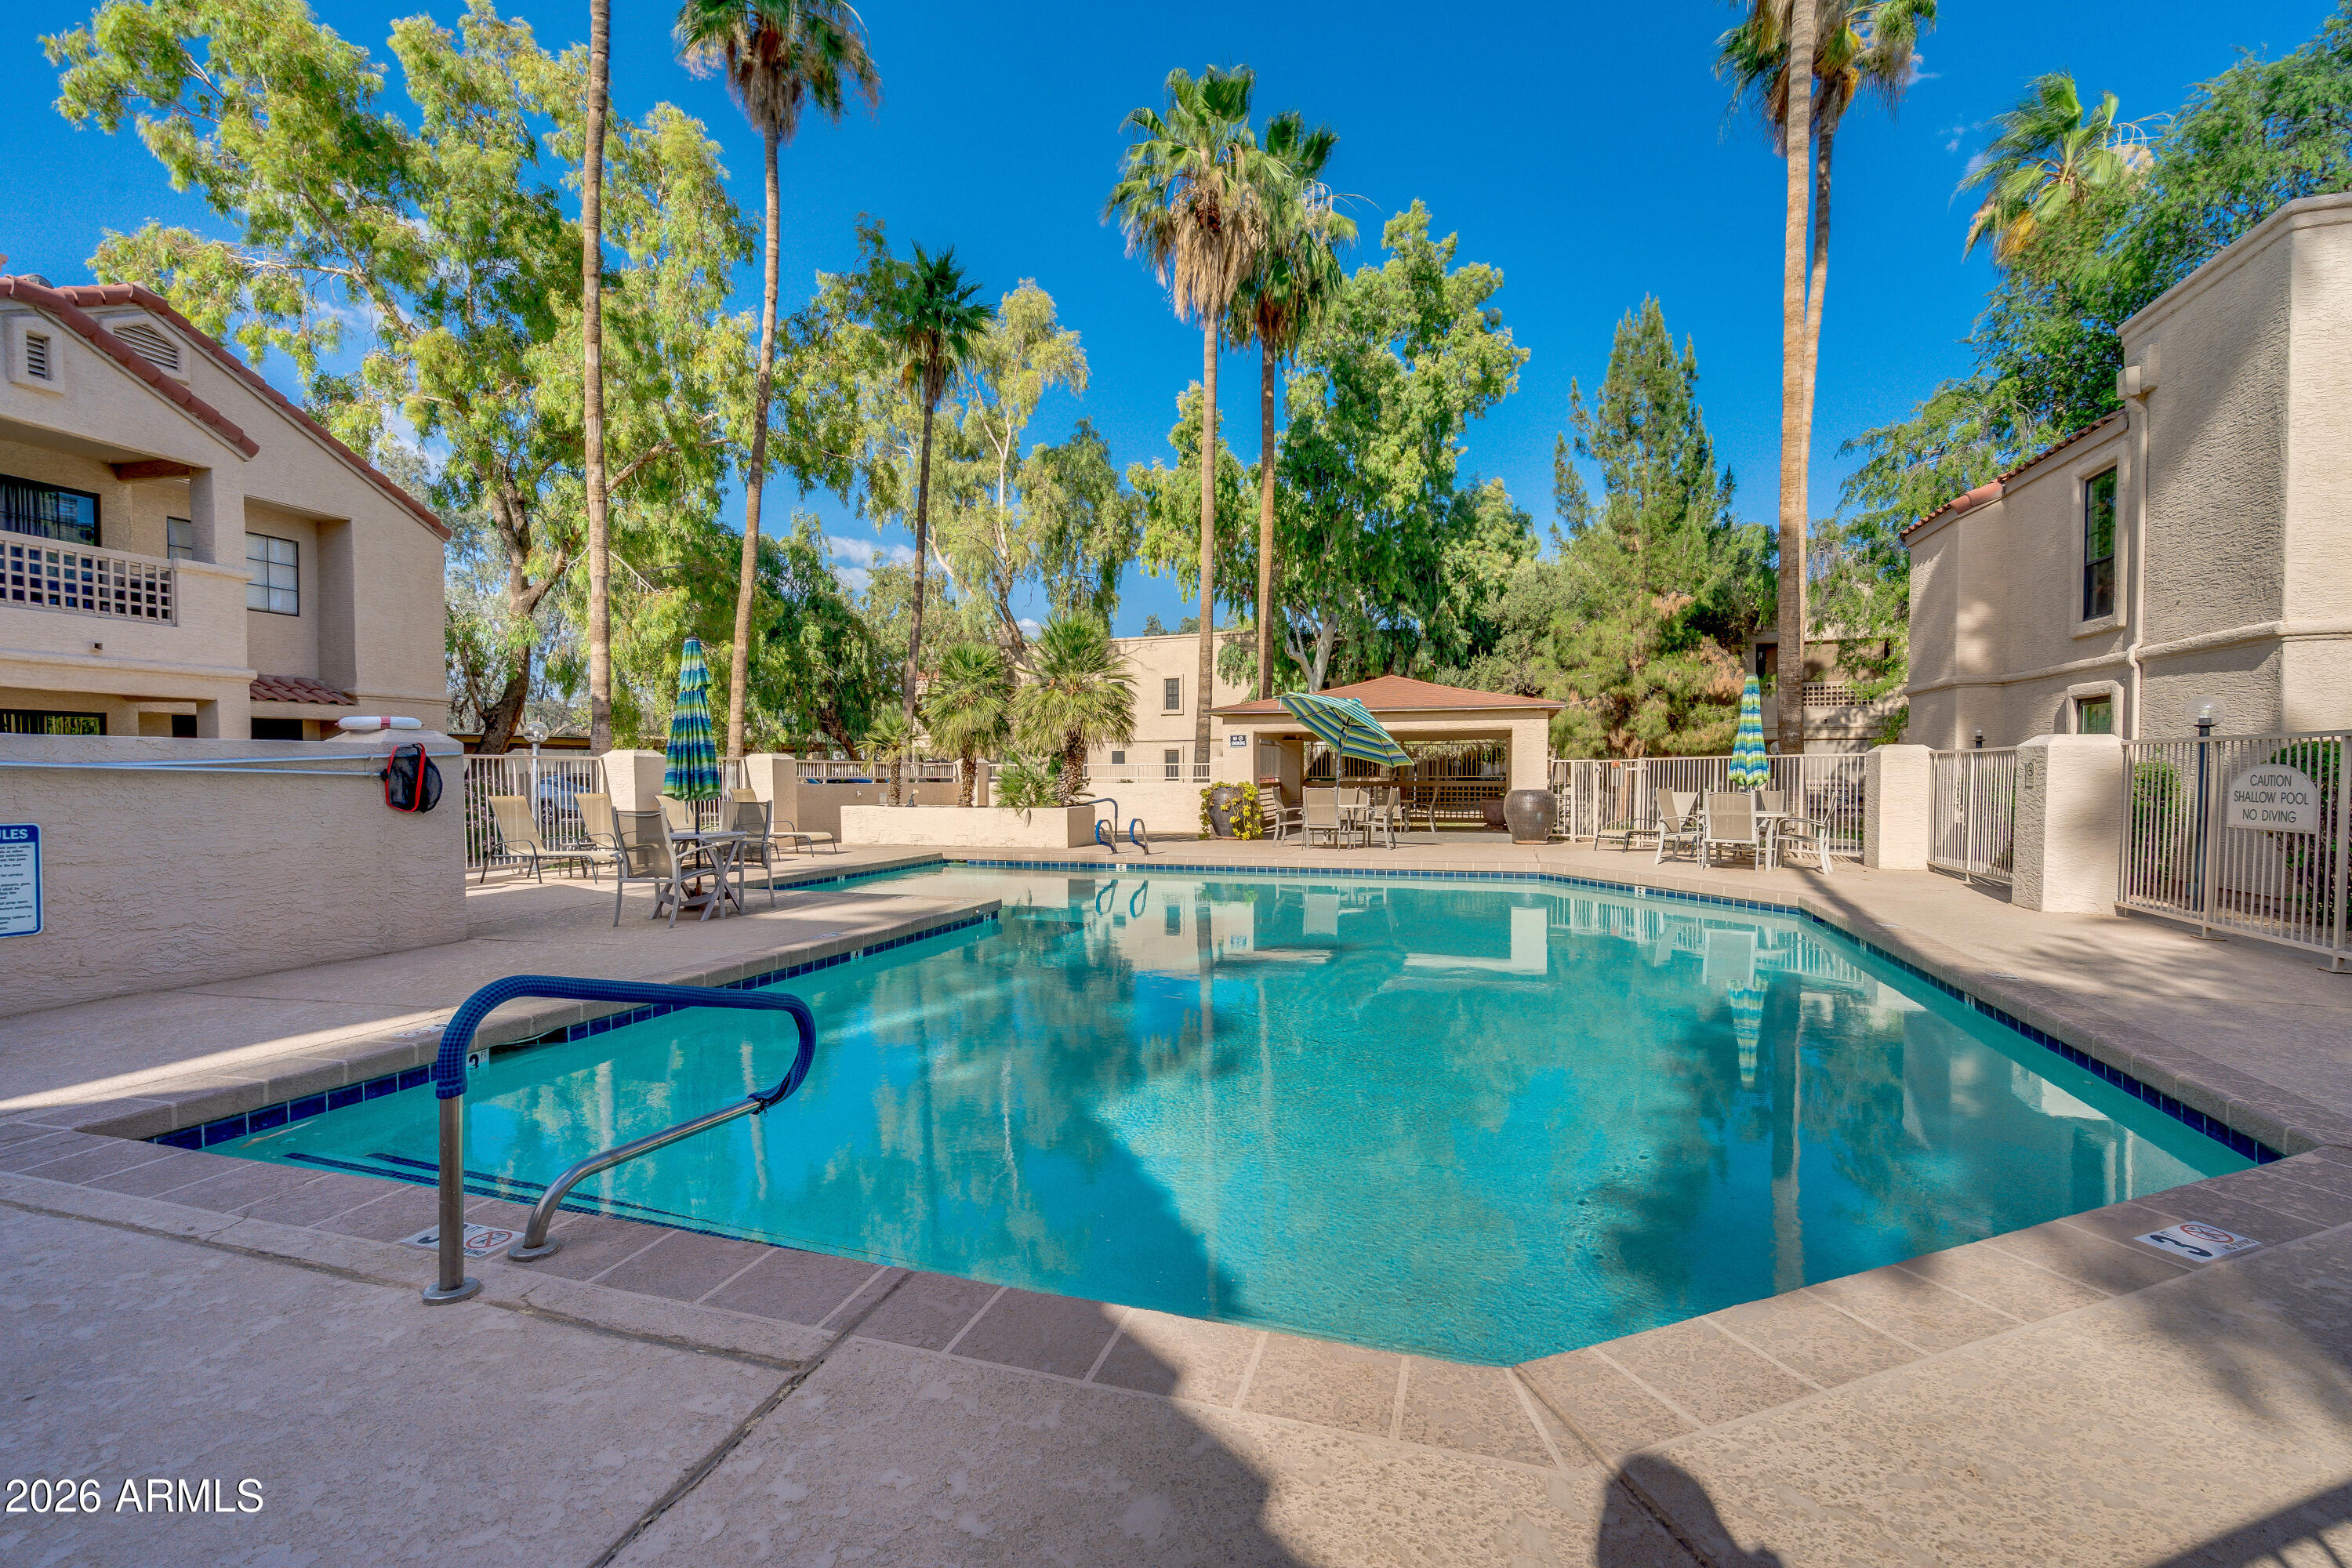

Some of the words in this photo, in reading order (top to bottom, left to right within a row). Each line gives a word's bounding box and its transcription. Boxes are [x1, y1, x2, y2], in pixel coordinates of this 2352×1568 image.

[2249, 774, 2292, 787] CAUTION
[2234, 790, 2277, 804] SHALLOW
[2280, 792, 2309, 805] POOL
[2242, 808, 2258, 821] NO
[2261, 809, 2297, 823] DIVING
[0, 829, 29, 840] LES
